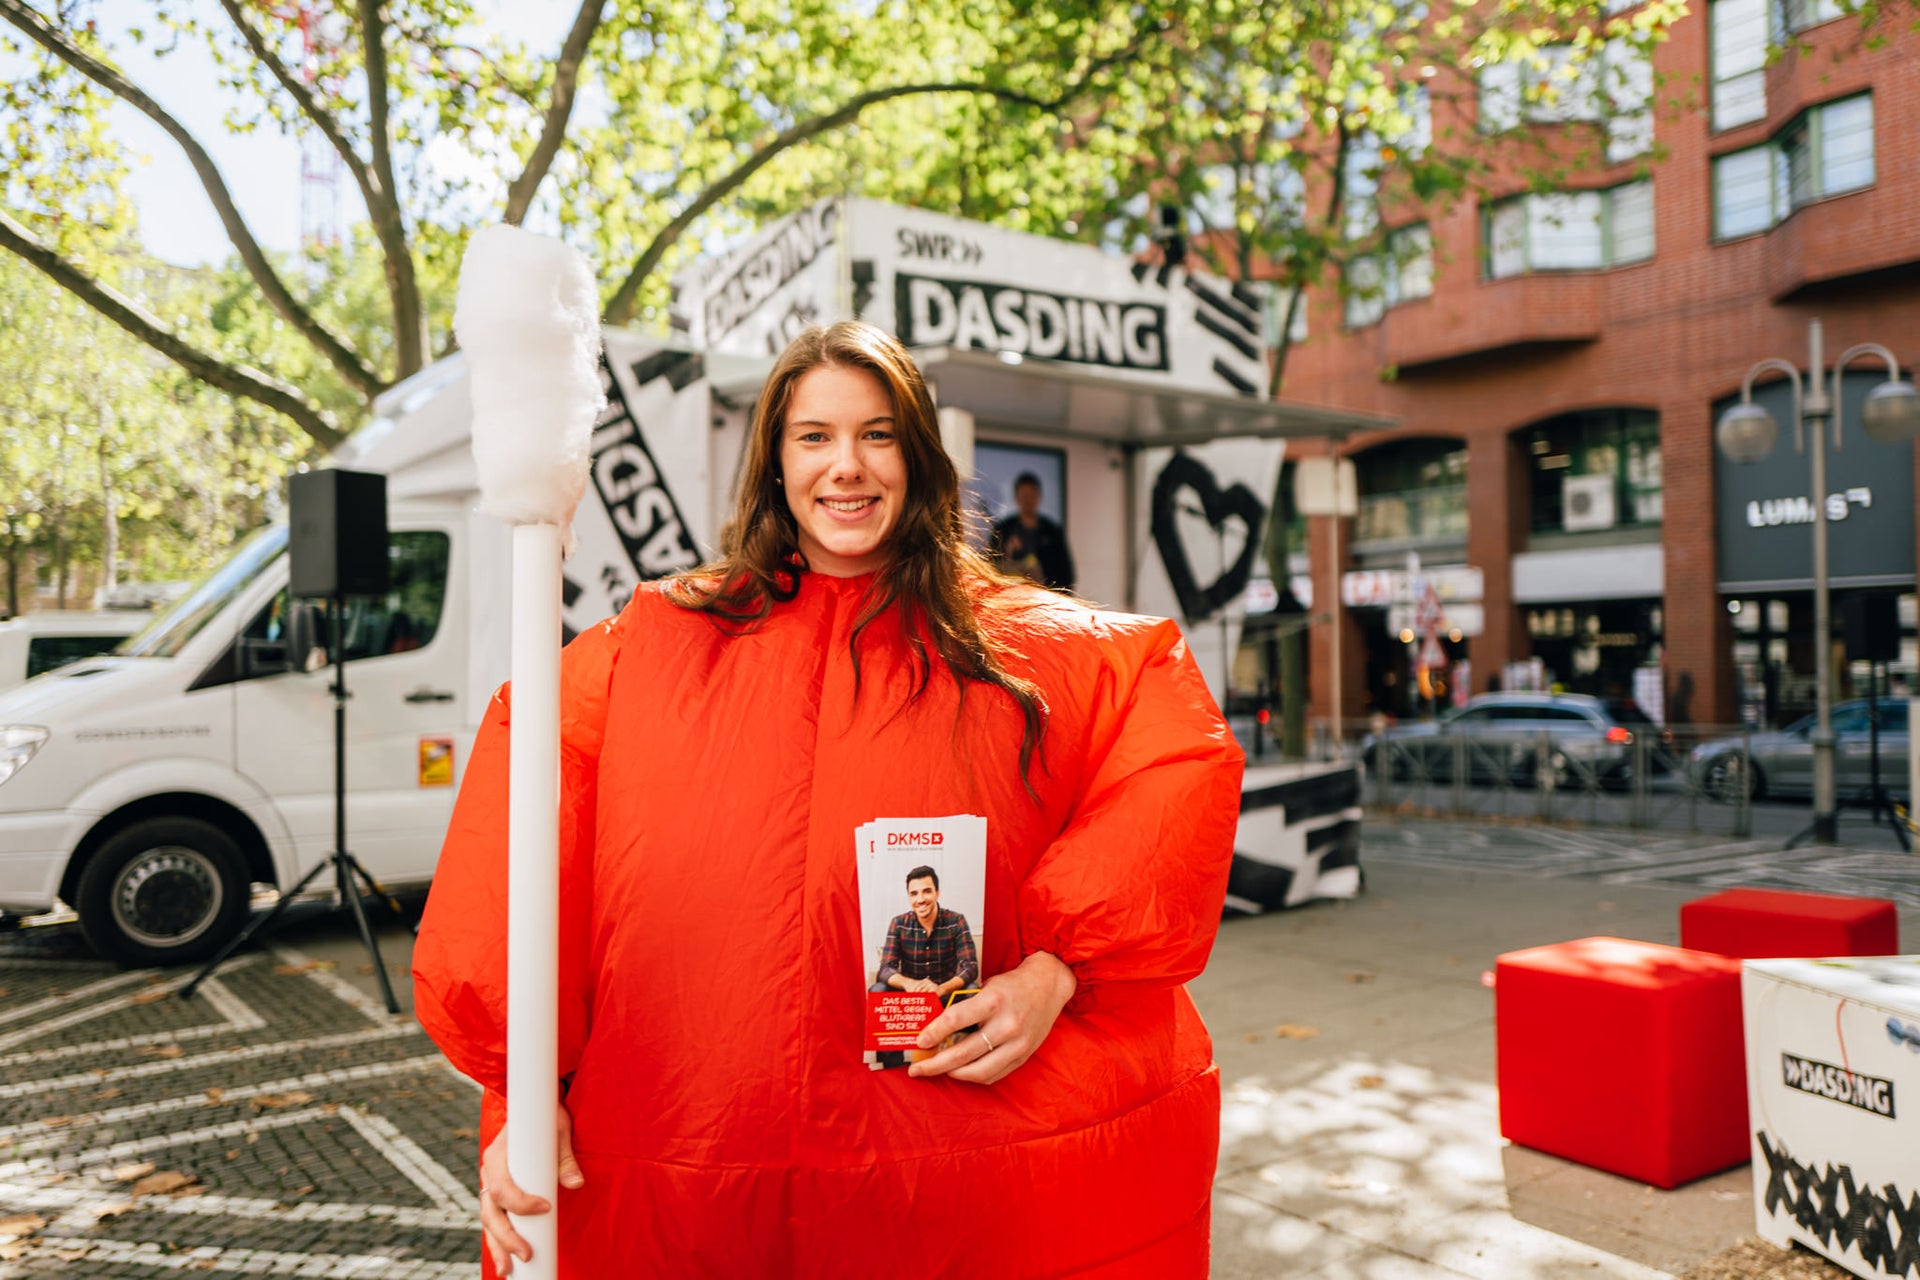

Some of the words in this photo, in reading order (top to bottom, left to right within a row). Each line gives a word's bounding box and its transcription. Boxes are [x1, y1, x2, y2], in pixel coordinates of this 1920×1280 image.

[897, 230, 956, 261] SWR
[908, 277, 1161, 366] DASDING
[887, 832, 930, 845] DKMS
[882, 997, 899, 1005] DAS
[901, 997, 926, 1005] BESTE
[904, 1005, 932, 1013] GEGEN
[879, 1014, 926, 1022] BLUTKREBS
[885, 1022, 905, 1030] SIND
[1800, 1059, 1891, 1114] DASDING
